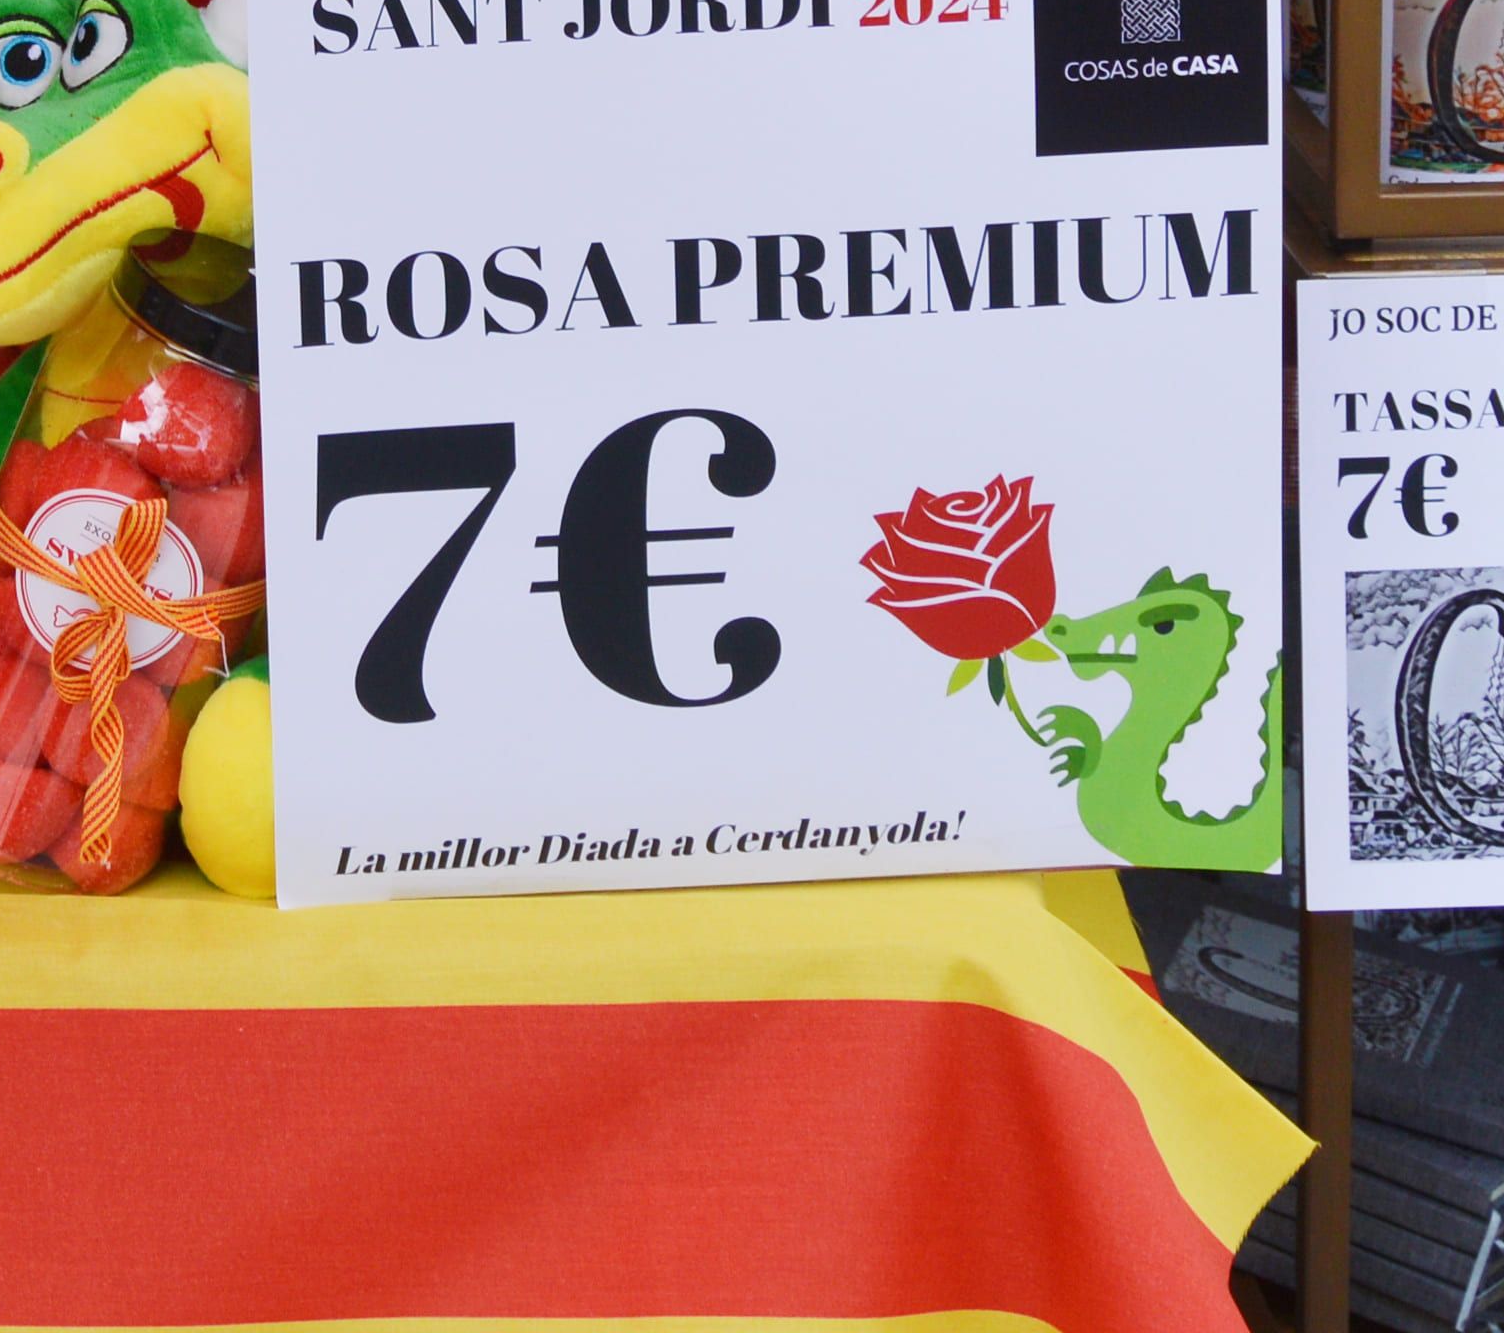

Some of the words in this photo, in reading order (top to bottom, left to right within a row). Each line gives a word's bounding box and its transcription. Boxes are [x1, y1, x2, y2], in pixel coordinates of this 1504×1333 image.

[1063, 58, 1139, 83] COSAS
[1141, 57, 1169, 80] de
[1170, 54, 1239, 77] CASA
[290, 239, 642, 350] ROSA
[664, 209, 1260, 327] PREMIUM
[1328, 306, 1366, 342] JO
[1374, 306, 1442, 335] SOC
[1450, 304, 1495, 333] DE
[1336, 452, 1461, 541] 7€
[313, 406, 783, 725] 7€
[334, 844, 390, 878] La
[396, 836, 531, 873] millor
[535, 828, 663, 868] Diada
[670, 831, 696, 858] a
[703, 809, 965, 862] Cerdanyola!
